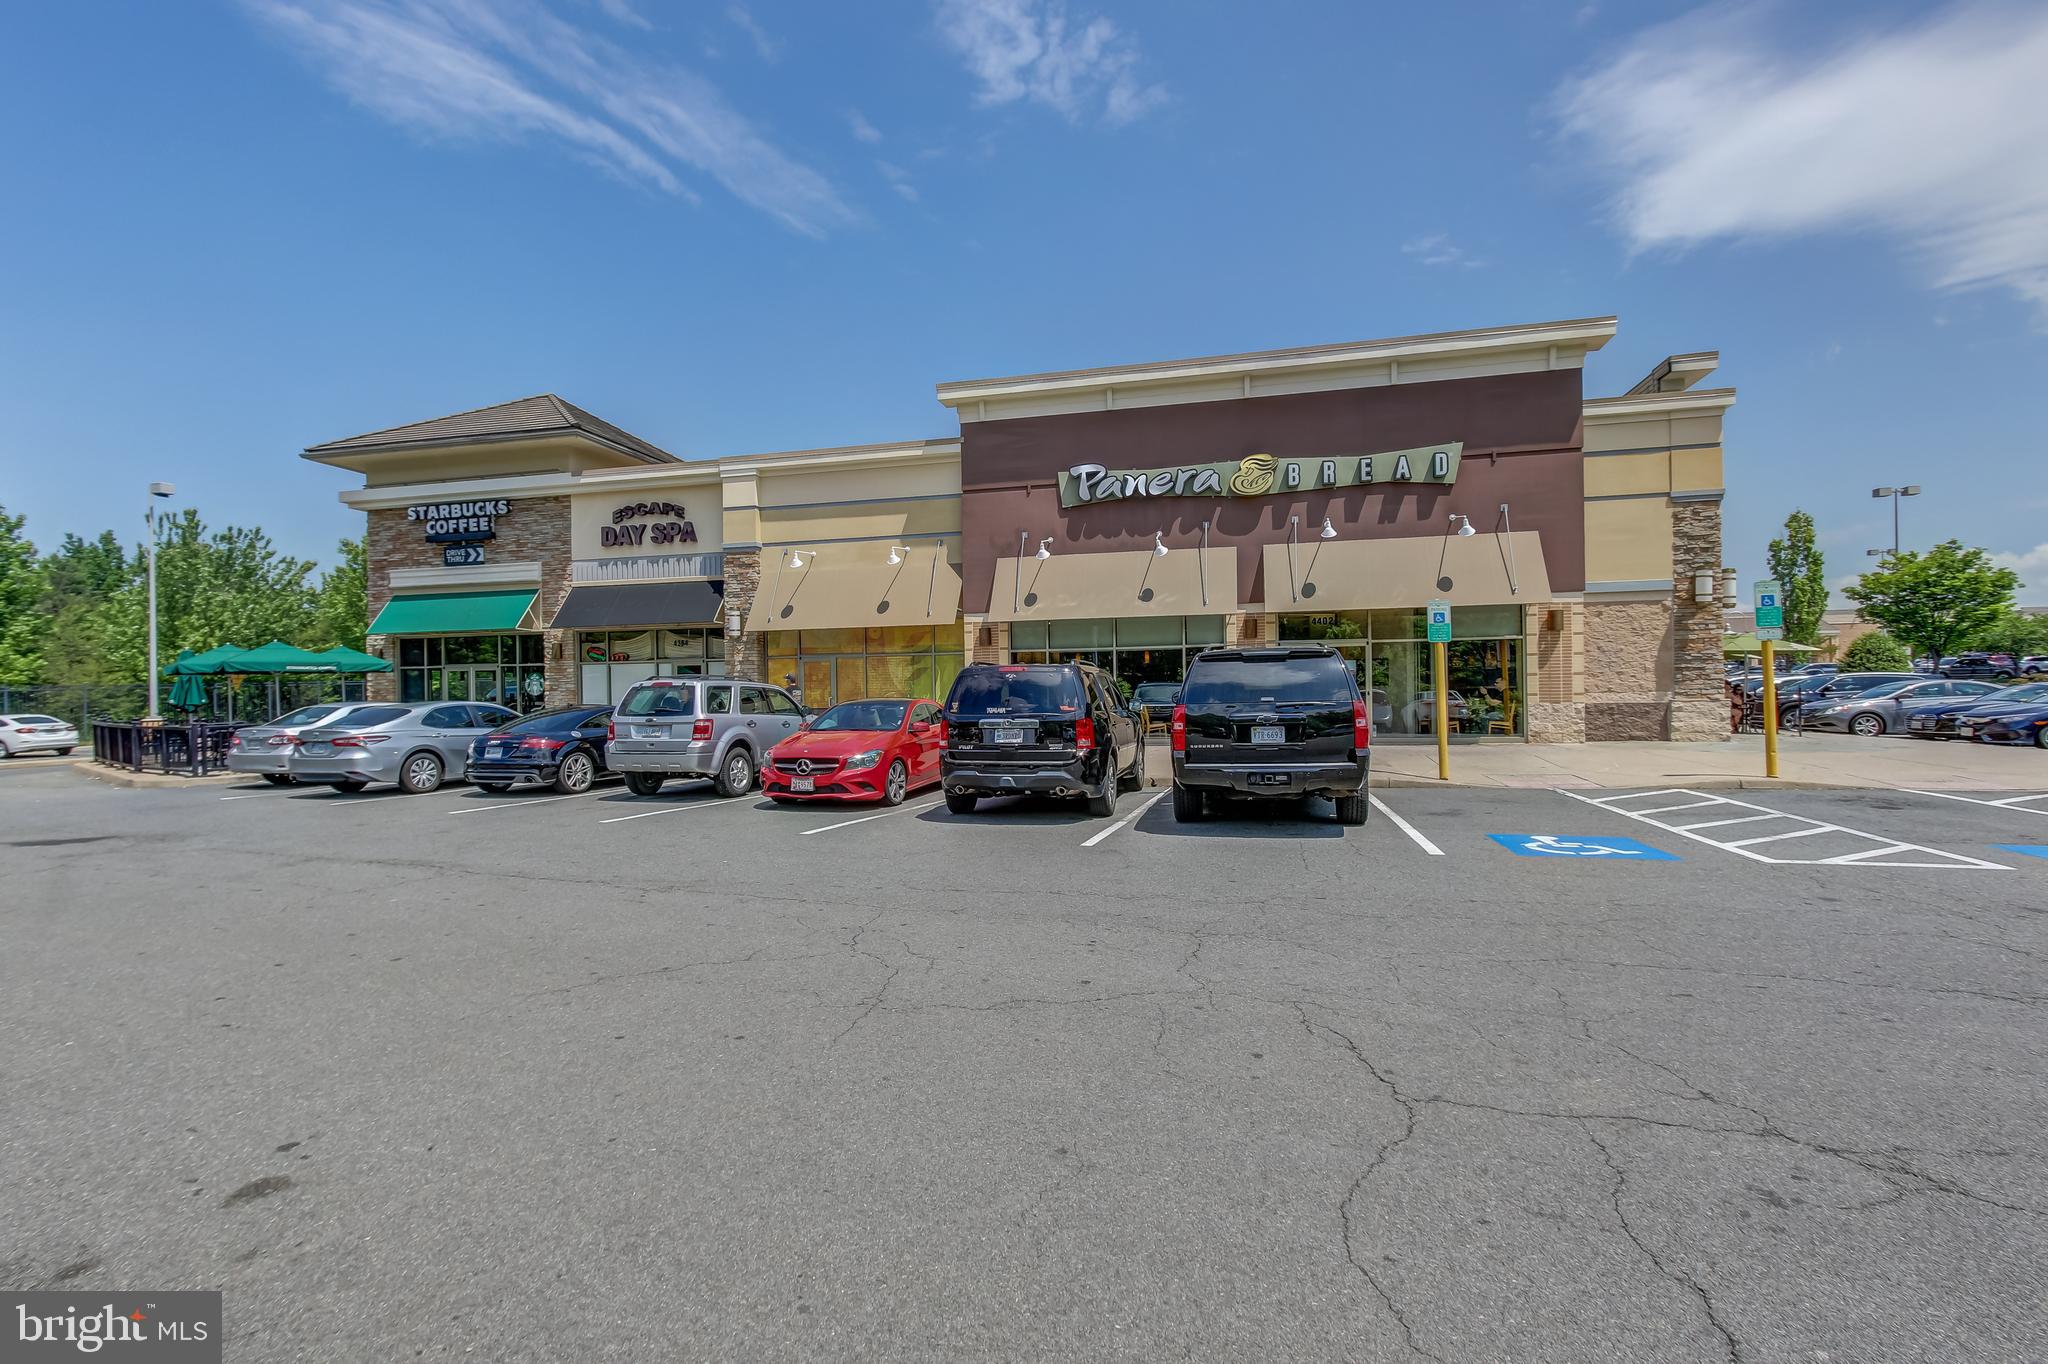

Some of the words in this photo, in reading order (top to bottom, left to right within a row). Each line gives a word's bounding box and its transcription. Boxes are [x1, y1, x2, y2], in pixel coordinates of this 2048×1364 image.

[1069, 463, 1221, 502] Panera
[1287, 452, 1450, 487] BREAD
[407, 500, 509, 521] STARBUCKS
[612, 502, 686, 525] ESCAPE
[426, 517, 490, 535] COFFEE
[601, 523, 648, 547] DAY
[650, 521, 699, 545] SPA
[445, 549, 466, 557] DRIVE
[1311, 616, 1334, 625] 4402
